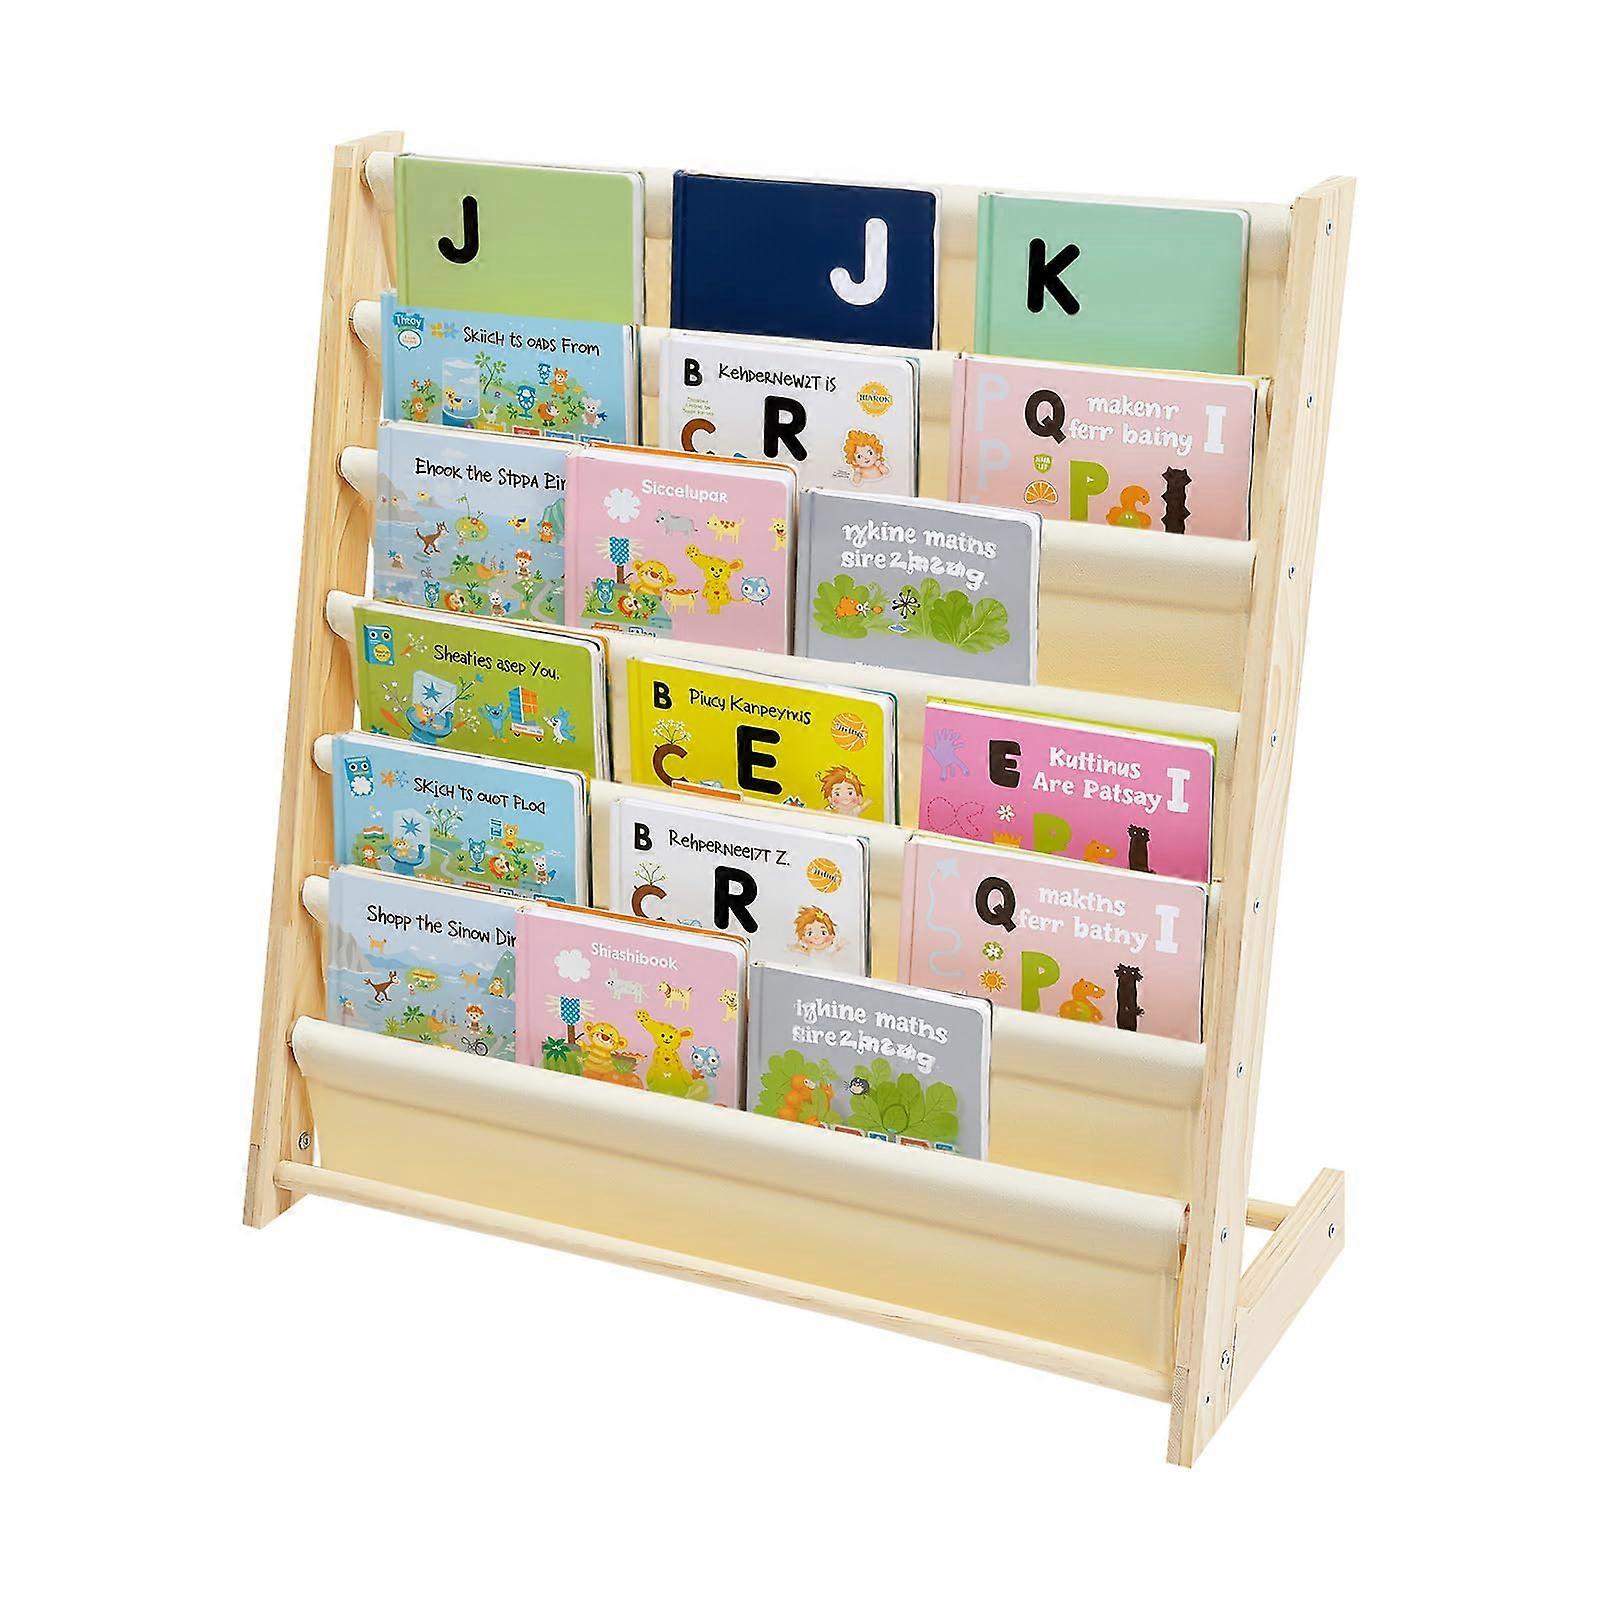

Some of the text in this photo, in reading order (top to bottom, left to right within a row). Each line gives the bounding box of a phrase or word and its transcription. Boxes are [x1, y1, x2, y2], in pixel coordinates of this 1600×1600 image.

[438, 195, 479, 264] J
[829, 217, 888, 306] J
[1026, 237, 1081, 315] K
[561, 338, 600, 356] From
[684, 358, 703, 386] B
[764, 396, 808, 461] R
[1025, 389, 1067, 444] Q
[466, 465, 493, 482] the
[434, 645, 492, 670] Sheaties
[529, 661, 560, 680] You.
[653, 681, 672, 710] B
[737, 725, 782, 795] E
[988, 739, 1021, 788] E
[1033, 771, 1163, 814] Are Patsay
[634, 823, 653, 851] B
[366, 904, 412, 932] Shopp
[415, 913, 443, 934] the
[714, 866, 758, 934] R
[975, 876, 1017, 933] Q
